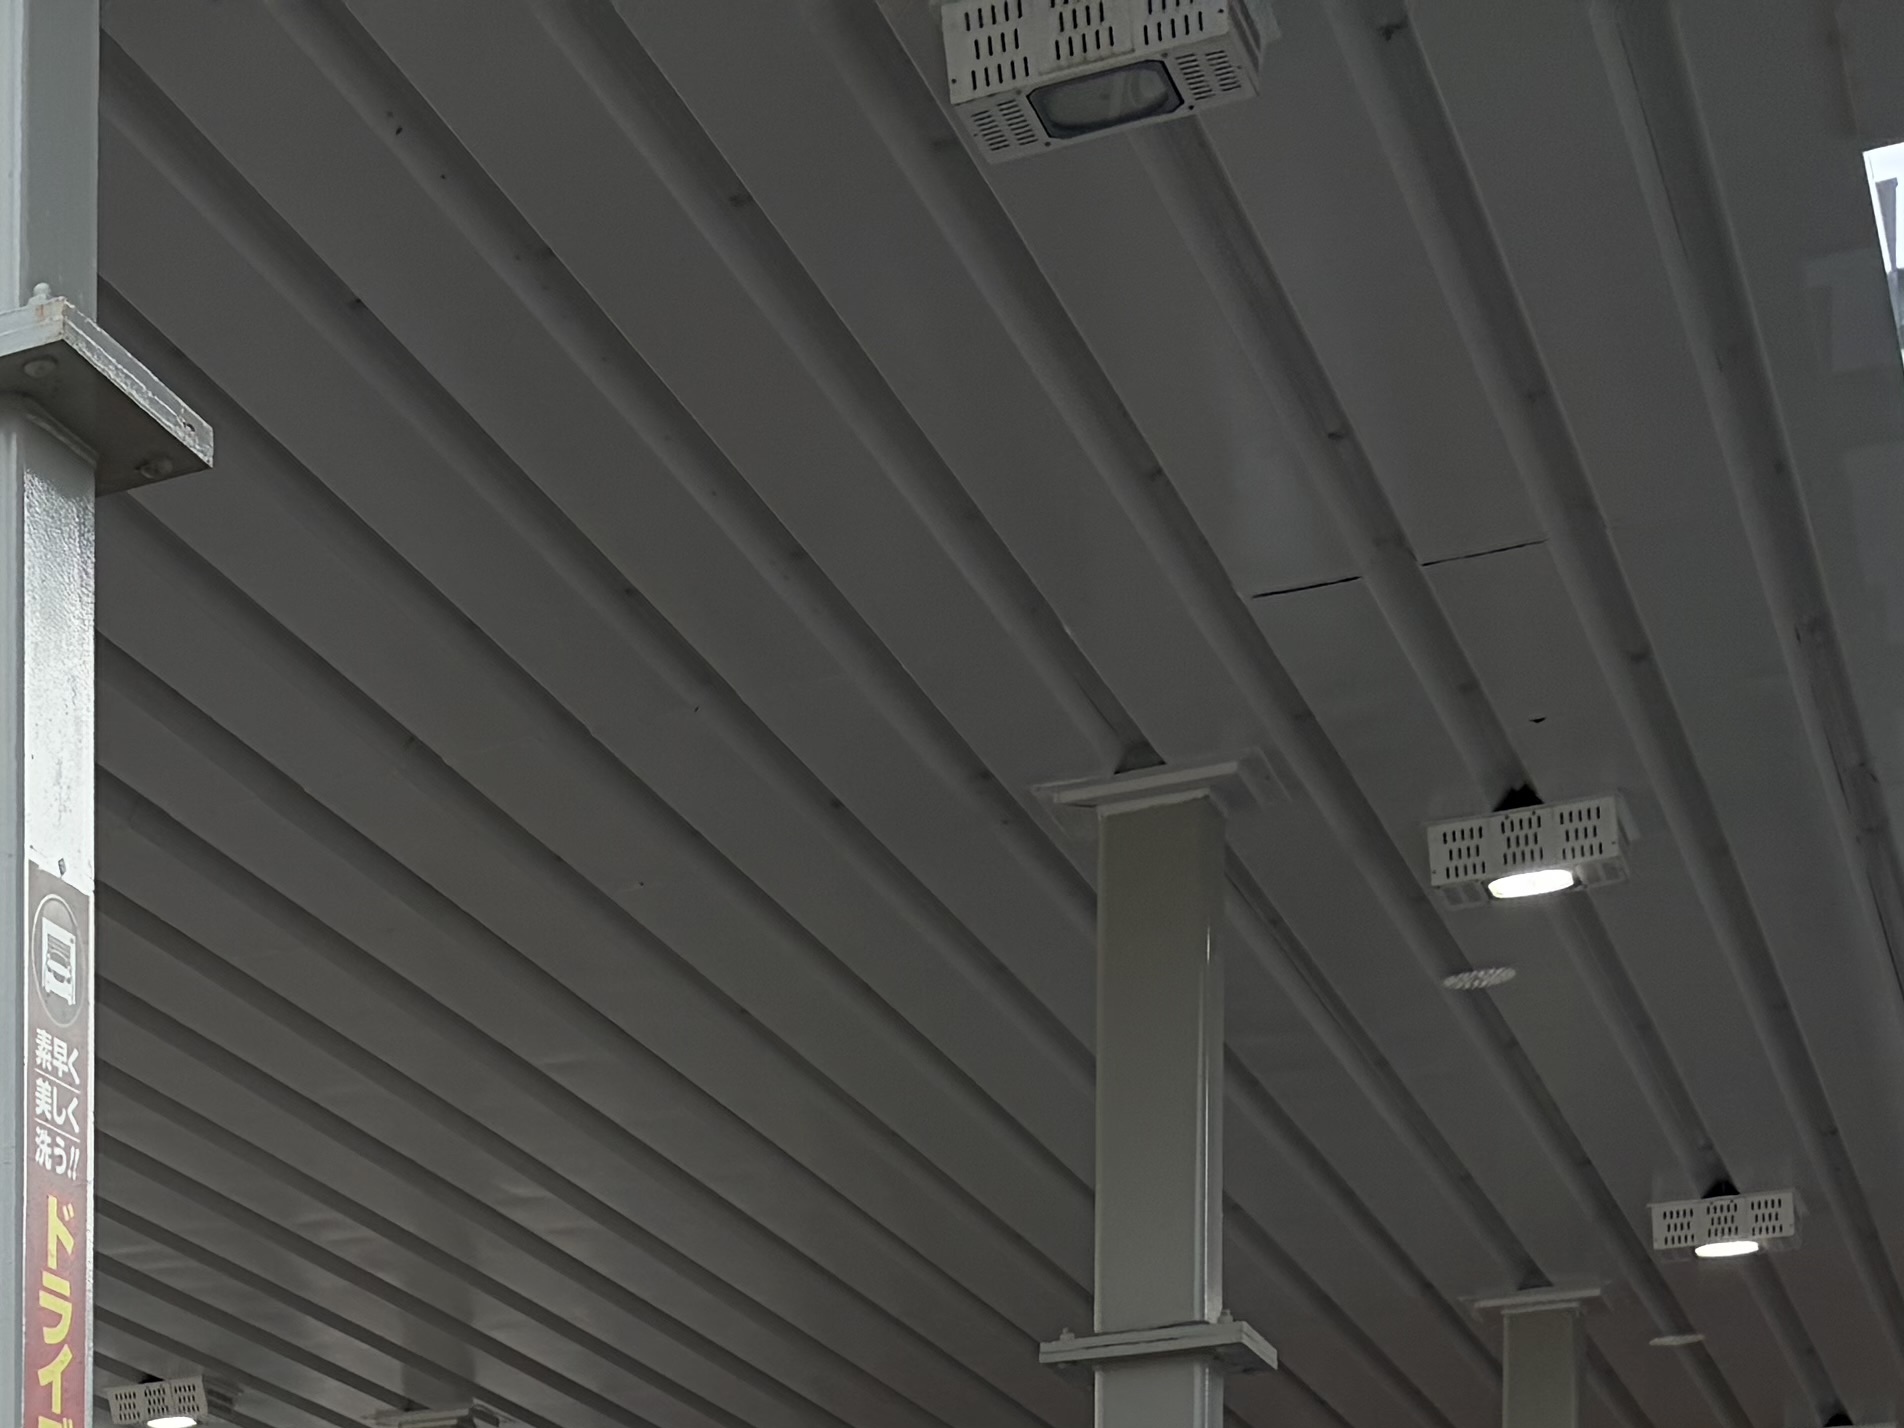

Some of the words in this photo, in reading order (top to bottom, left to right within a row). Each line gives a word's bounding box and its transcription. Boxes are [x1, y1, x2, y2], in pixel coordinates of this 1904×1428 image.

[34, 1028, 80, 1086] 素早く
[34, 1076, 80, 1134] 美しく
